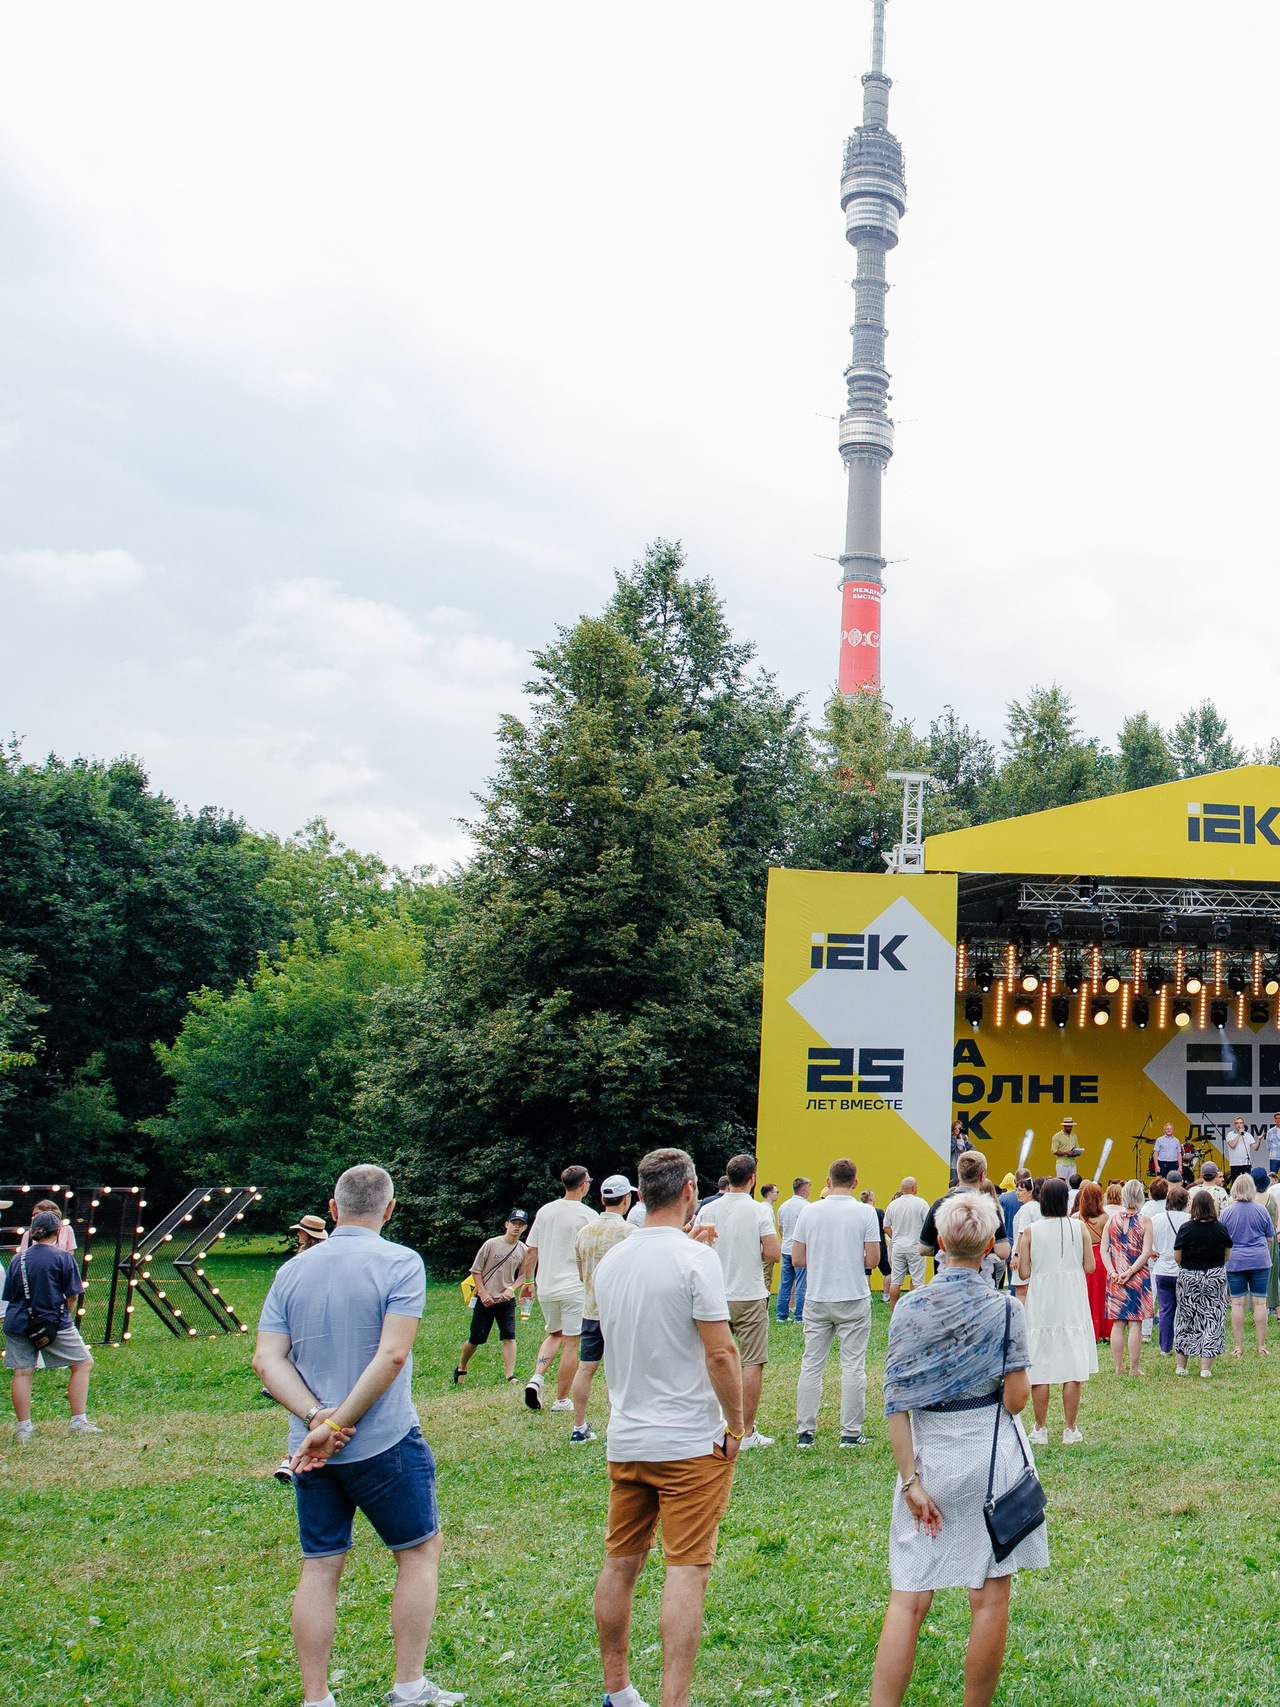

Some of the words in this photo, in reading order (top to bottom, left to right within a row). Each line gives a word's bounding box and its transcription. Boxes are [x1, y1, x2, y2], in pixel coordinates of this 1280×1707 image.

[806, 1047, 904, 1093] 25
[806, 1099, 837, 1110] ЛЕТ
[840, 1099, 903, 1110] ВМЕСТЕ
[1186, 1124, 1230, 1141] ЛЕТ
